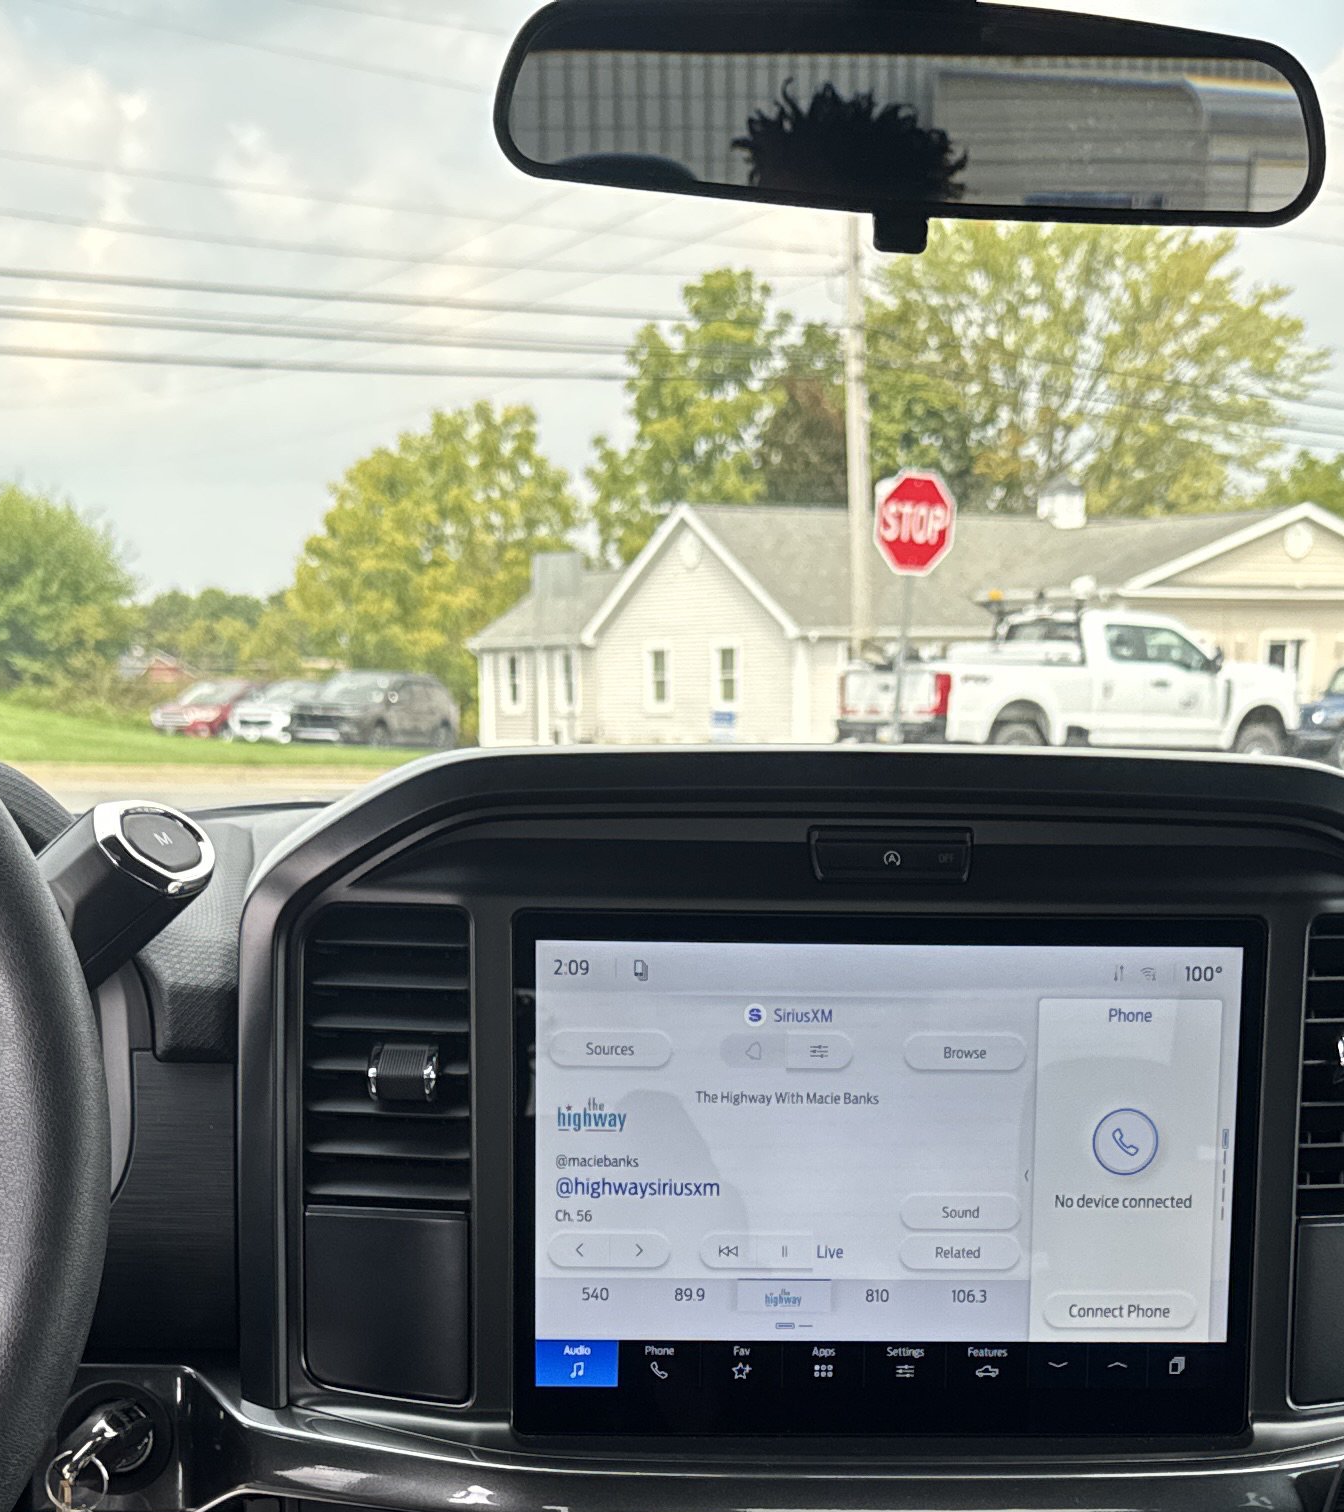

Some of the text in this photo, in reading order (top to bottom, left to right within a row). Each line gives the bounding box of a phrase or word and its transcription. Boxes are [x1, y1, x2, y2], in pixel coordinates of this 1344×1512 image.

[880, 499, 946, 544] STOP
[153, 831, 174, 846] M
[553, 959, 590, 977] 2:09
[773, 1007, 833, 1025] SiriusXM
[1108, 1007, 1153, 1025] Phone
[586, 1042, 635, 1058] Sources
[943, 1045, 987, 1060] Browse
[587, 1098, 605, 1113] the
[695, 1091, 880, 1107] The Highway With Macie Banks
[556, 1105, 627, 1132] highway
[555, 1154, 640, 1170] @maciebanks
[556, 1177, 720, 1200] @highwaysiriusxm
[1055, 1193, 1192, 1210] No device connected
[555, 1209, 593, 1224] Ch. 56
[942, 1205, 980, 1221] Sound
[817, 1244, 844, 1260] Live
[935, 1245, 981, 1260] Related
[581, 1287, 609, 1302] 540
[674, 1288, 706, 1303] 89.9
[764, 1293, 802, 1307] highway
[865, 1288, 890, 1303] 810
[951, 1289, 988, 1304] 106.3
[1068, 1304, 1170, 1319] Connect Phone
[563, 1344, 591, 1357] Audio
[644, 1344, 675, 1357] Phone
[733, 1345, 750, 1357] Fav
[812, 1345, 836, 1360] Apps
[887, 1345, 925, 1360] Settings
[967, 1346, 1008, 1358] Features
